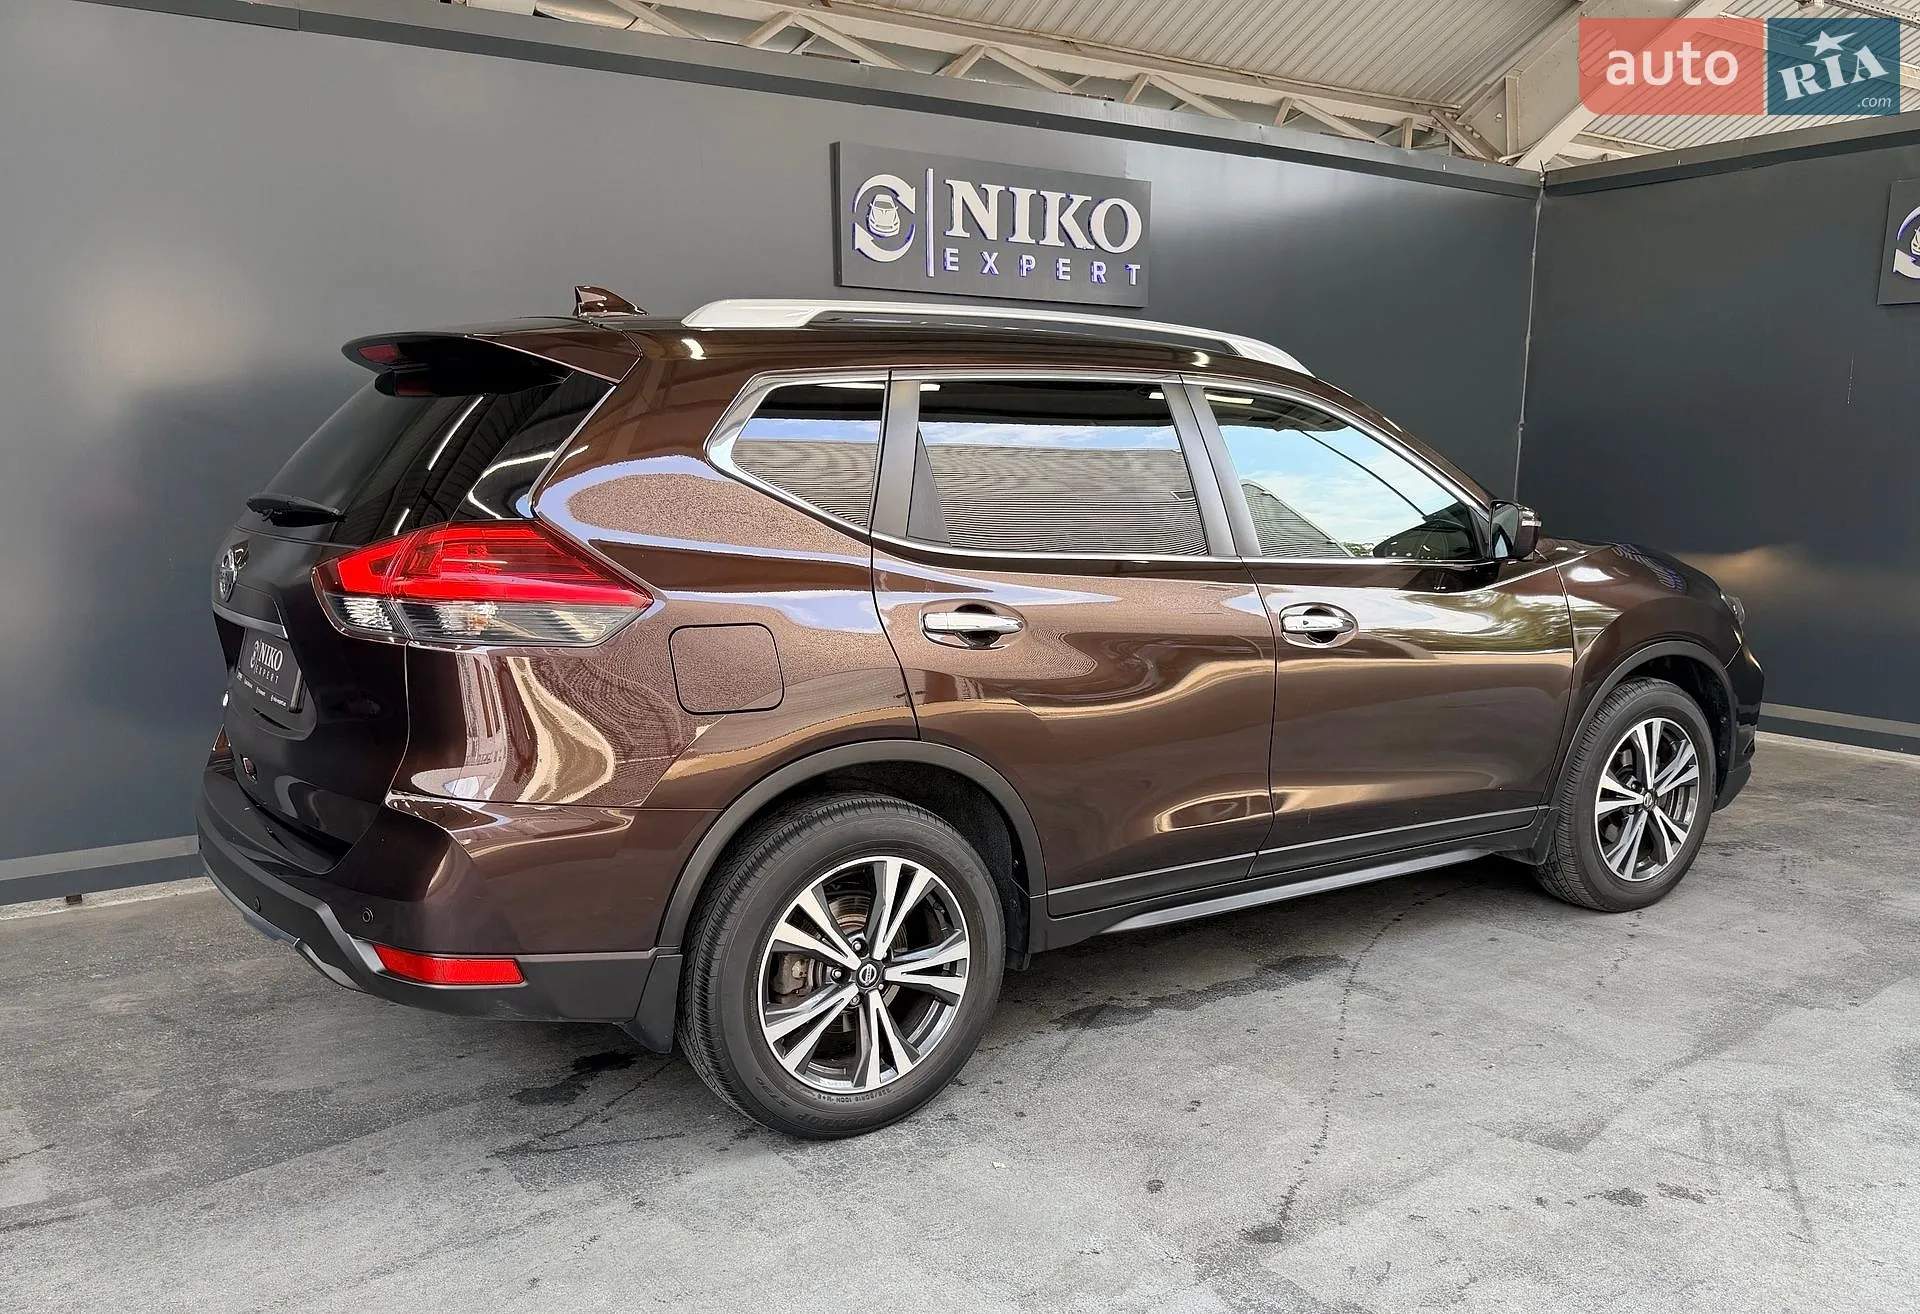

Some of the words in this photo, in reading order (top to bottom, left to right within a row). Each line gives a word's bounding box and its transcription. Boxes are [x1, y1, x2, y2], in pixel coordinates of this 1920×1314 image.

[944, 178, 1142, 254] NIKO
[943, 247, 1141, 286] EXPERT
[259, 641, 283, 672] NIKO
